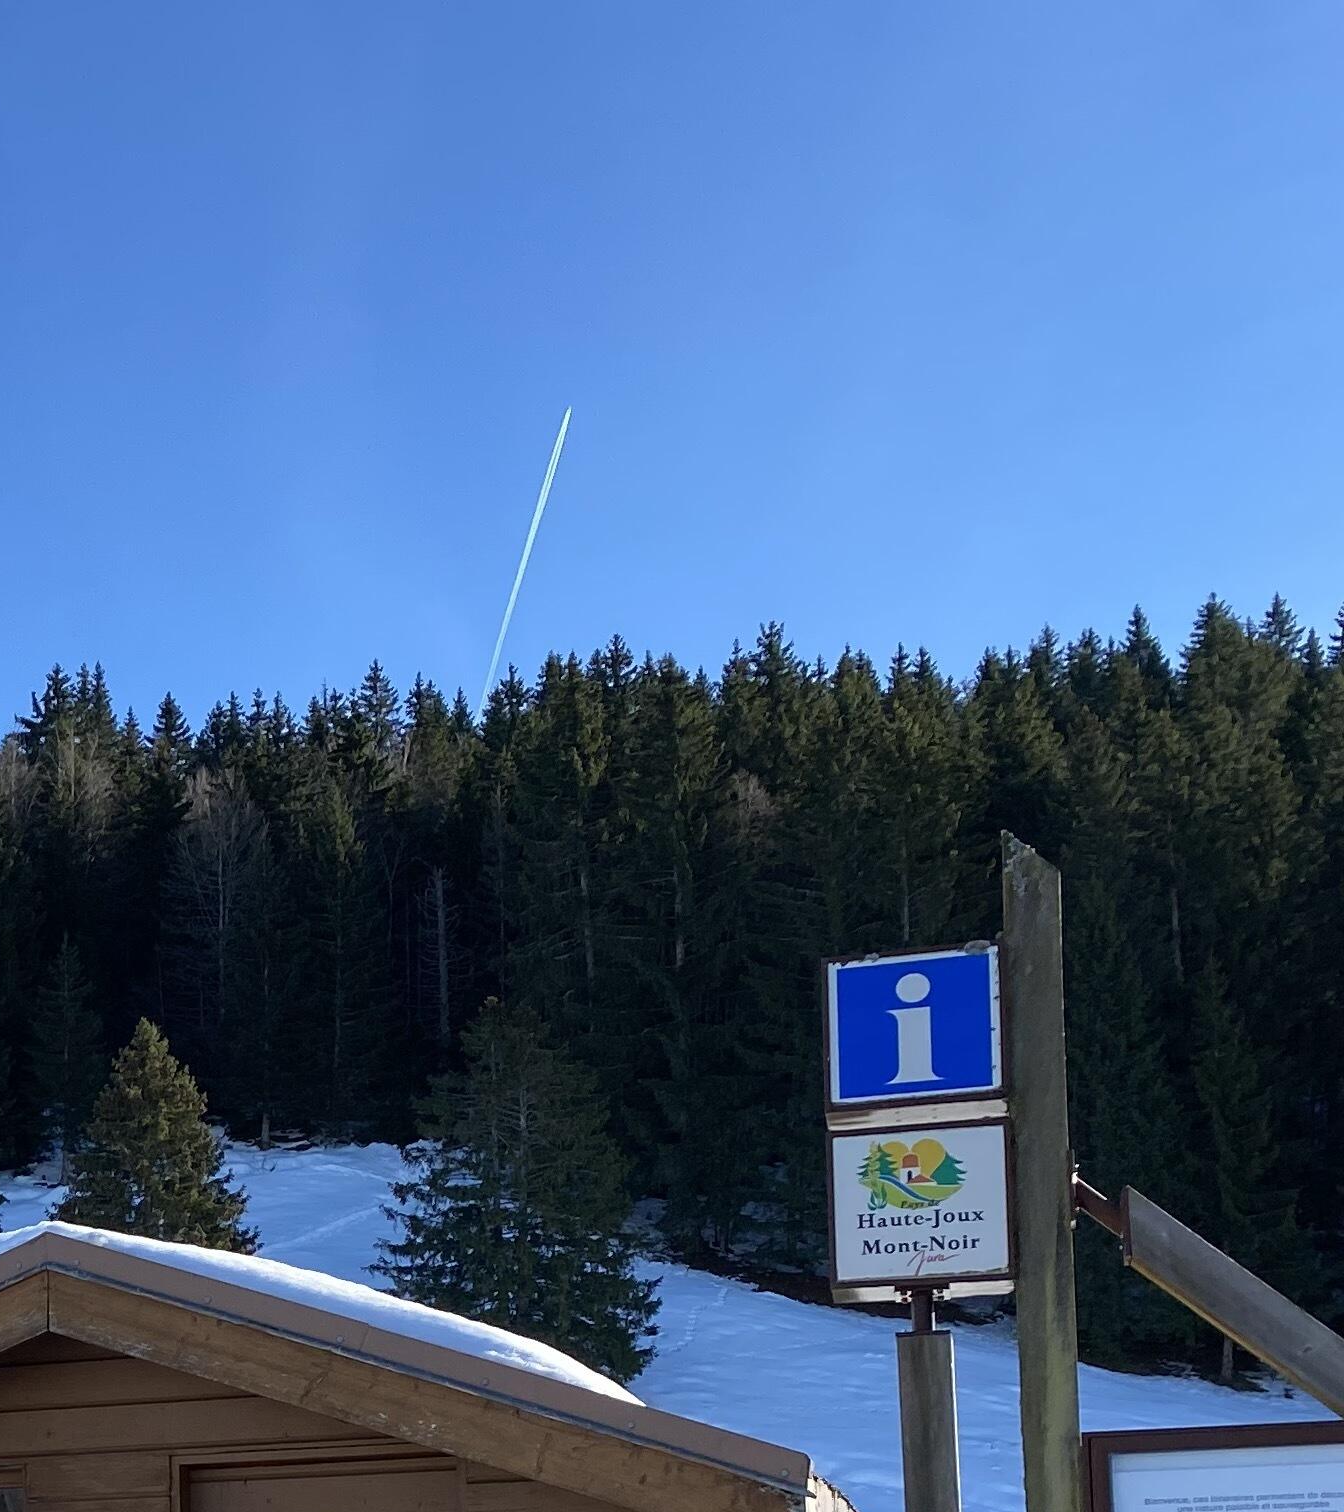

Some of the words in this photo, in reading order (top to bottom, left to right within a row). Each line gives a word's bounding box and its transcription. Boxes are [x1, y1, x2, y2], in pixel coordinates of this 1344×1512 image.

[857, 1209, 985, 1229] Haute-Joux
[862, 1235, 981, 1255] Mont-Noir
[907, 1250, 961, 1277] Jura
